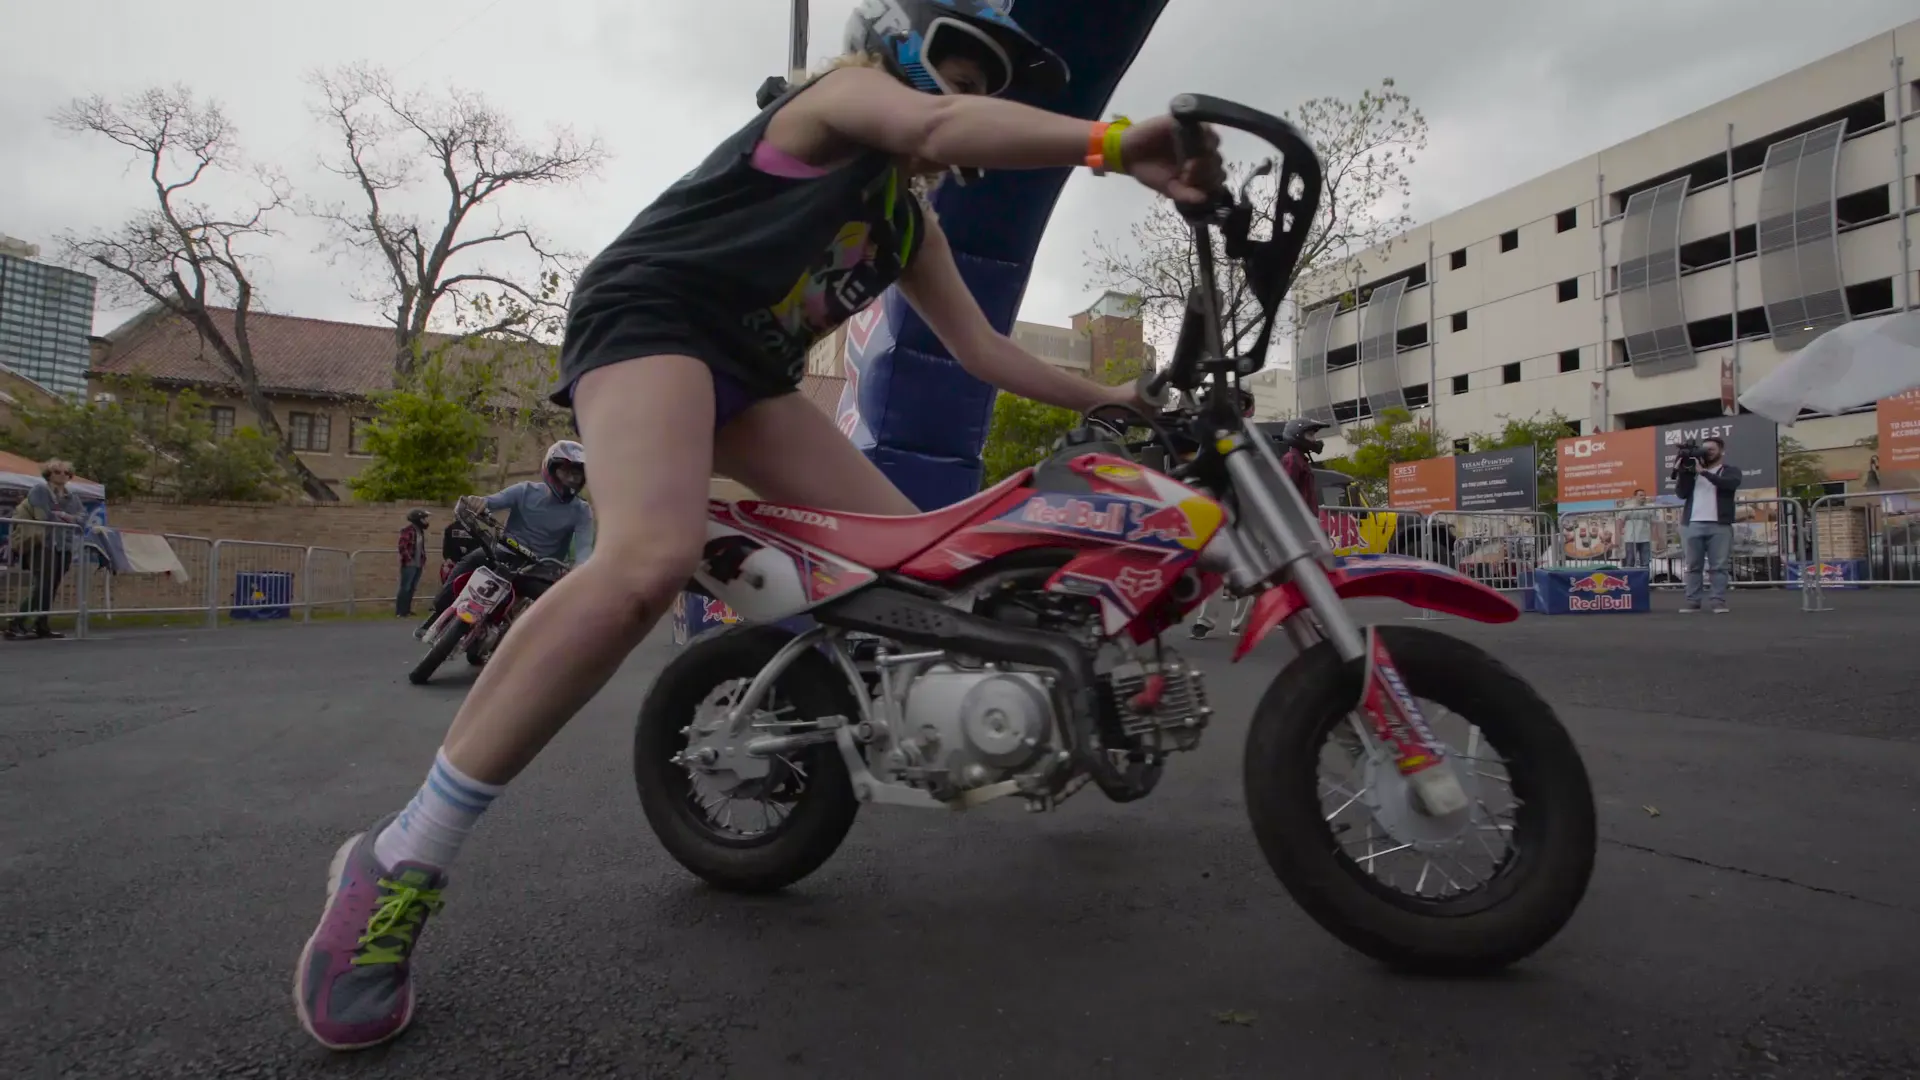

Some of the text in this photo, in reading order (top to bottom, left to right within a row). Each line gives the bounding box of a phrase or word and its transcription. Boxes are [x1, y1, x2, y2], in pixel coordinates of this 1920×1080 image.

[1684, 425, 1733, 439] WEST
[1564, 440, 1606, 457] BLOCK
[1393, 465, 1417, 476] CREST
[1461, 461, 1481, 469] TEXAN
[1487, 457, 1514, 465] VINTAGE
[753, 503, 838, 531] HONDA
[1022, 497, 1126, 535] Red Bull
[477, 580, 500, 598] 3
[1569, 593, 1632, 610] Red Bull
